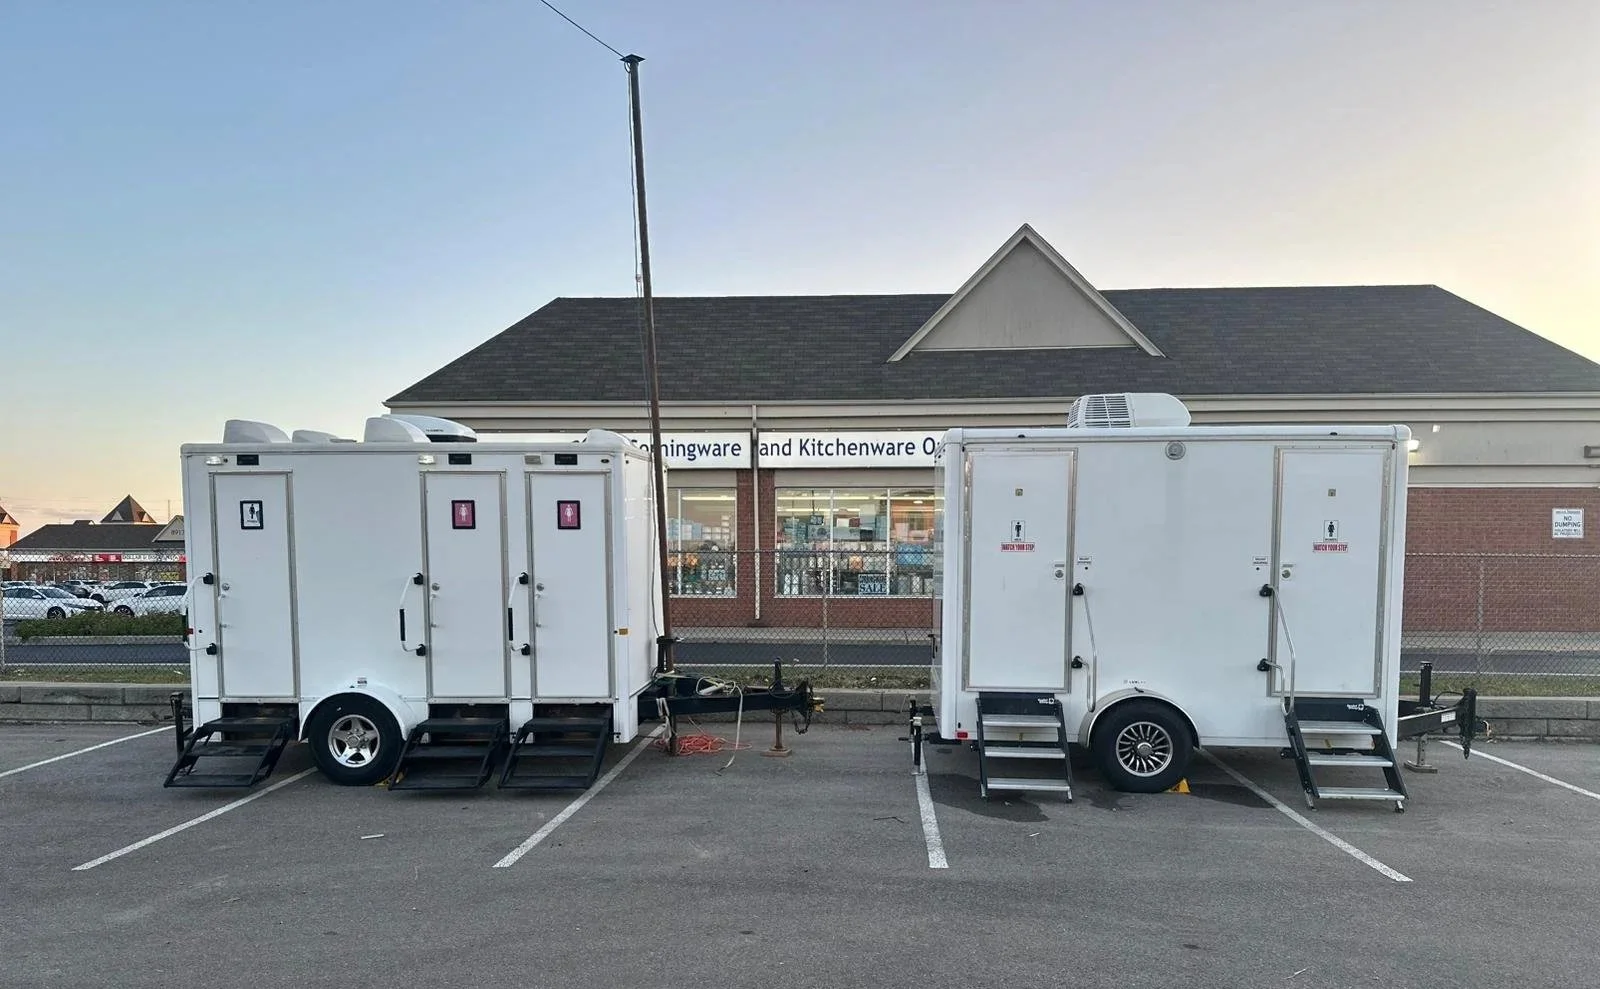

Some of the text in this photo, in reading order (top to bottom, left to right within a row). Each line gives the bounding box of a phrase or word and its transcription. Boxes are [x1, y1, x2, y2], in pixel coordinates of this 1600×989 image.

[759, 438, 792, 456] and
[799, 438, 916, 457] Kitchenware
[859, 583, 887, 593] SALE
